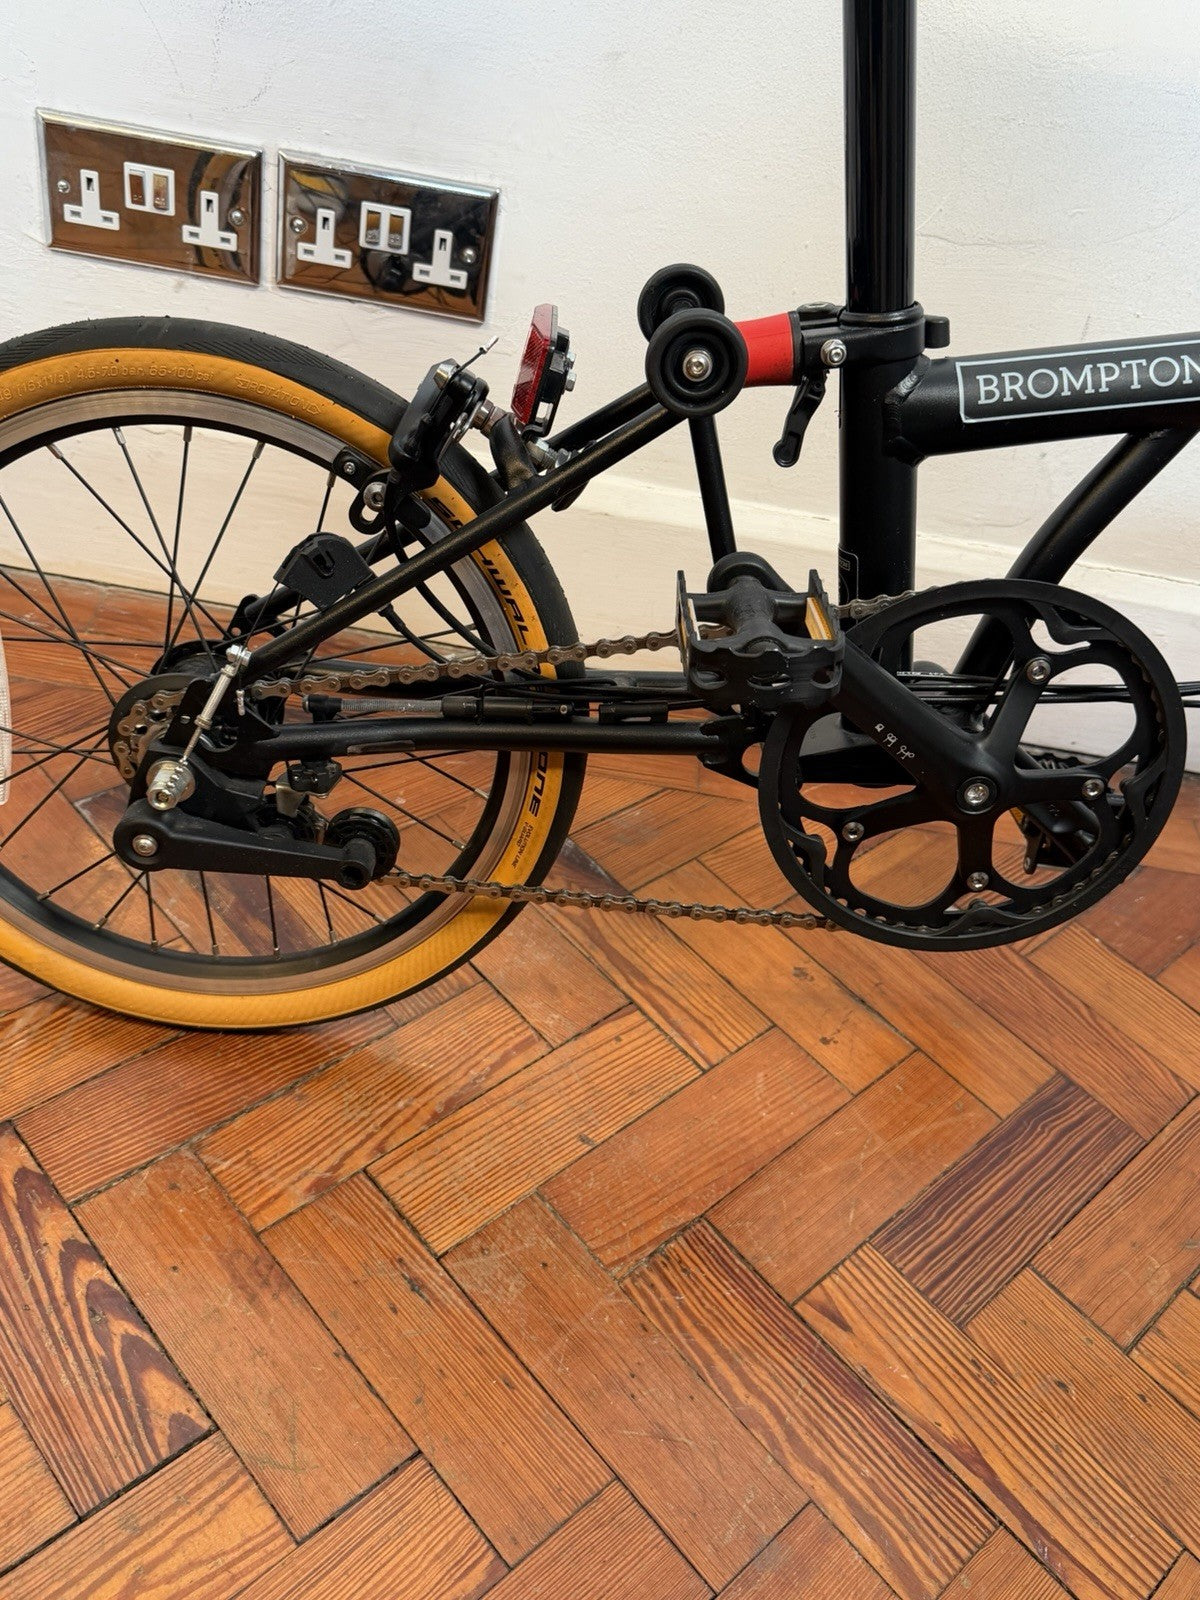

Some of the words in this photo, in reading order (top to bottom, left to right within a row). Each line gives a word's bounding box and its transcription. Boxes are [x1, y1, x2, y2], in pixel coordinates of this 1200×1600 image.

[148, 365, 194, 380] 65-100
[976, 355, 1200, 405] BROMPTON
[250, 381, 308, 411] ROTATION
[529, 752, 548, 817] ONE
